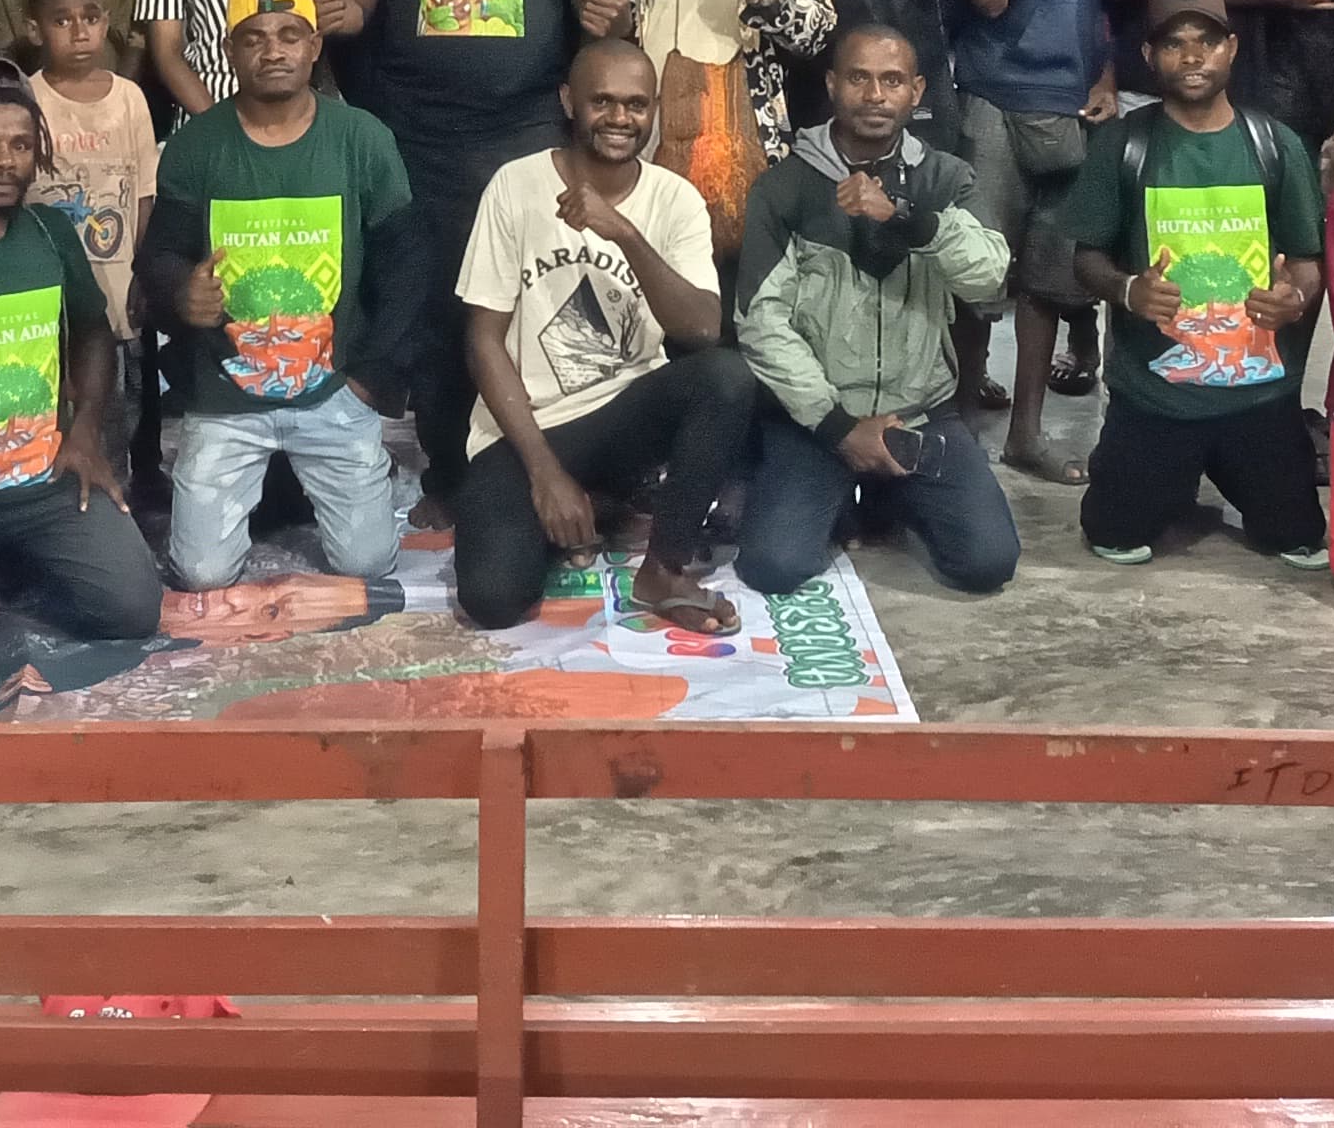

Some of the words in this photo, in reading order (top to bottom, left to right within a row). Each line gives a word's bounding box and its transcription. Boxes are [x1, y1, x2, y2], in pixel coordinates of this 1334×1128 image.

[1179, 206, 1239, 216] FESTIVAL
[246, 218, 307, 229] FESTIVAL
[1156, 219, 1215, 234] HUTAN
[1219, 217, 1262, 232] ADAT
[222, 232, 281, 247] HUTAN
[285, 229, 331, 245] ADAT
[20, 321, 60, 342] ADAT
